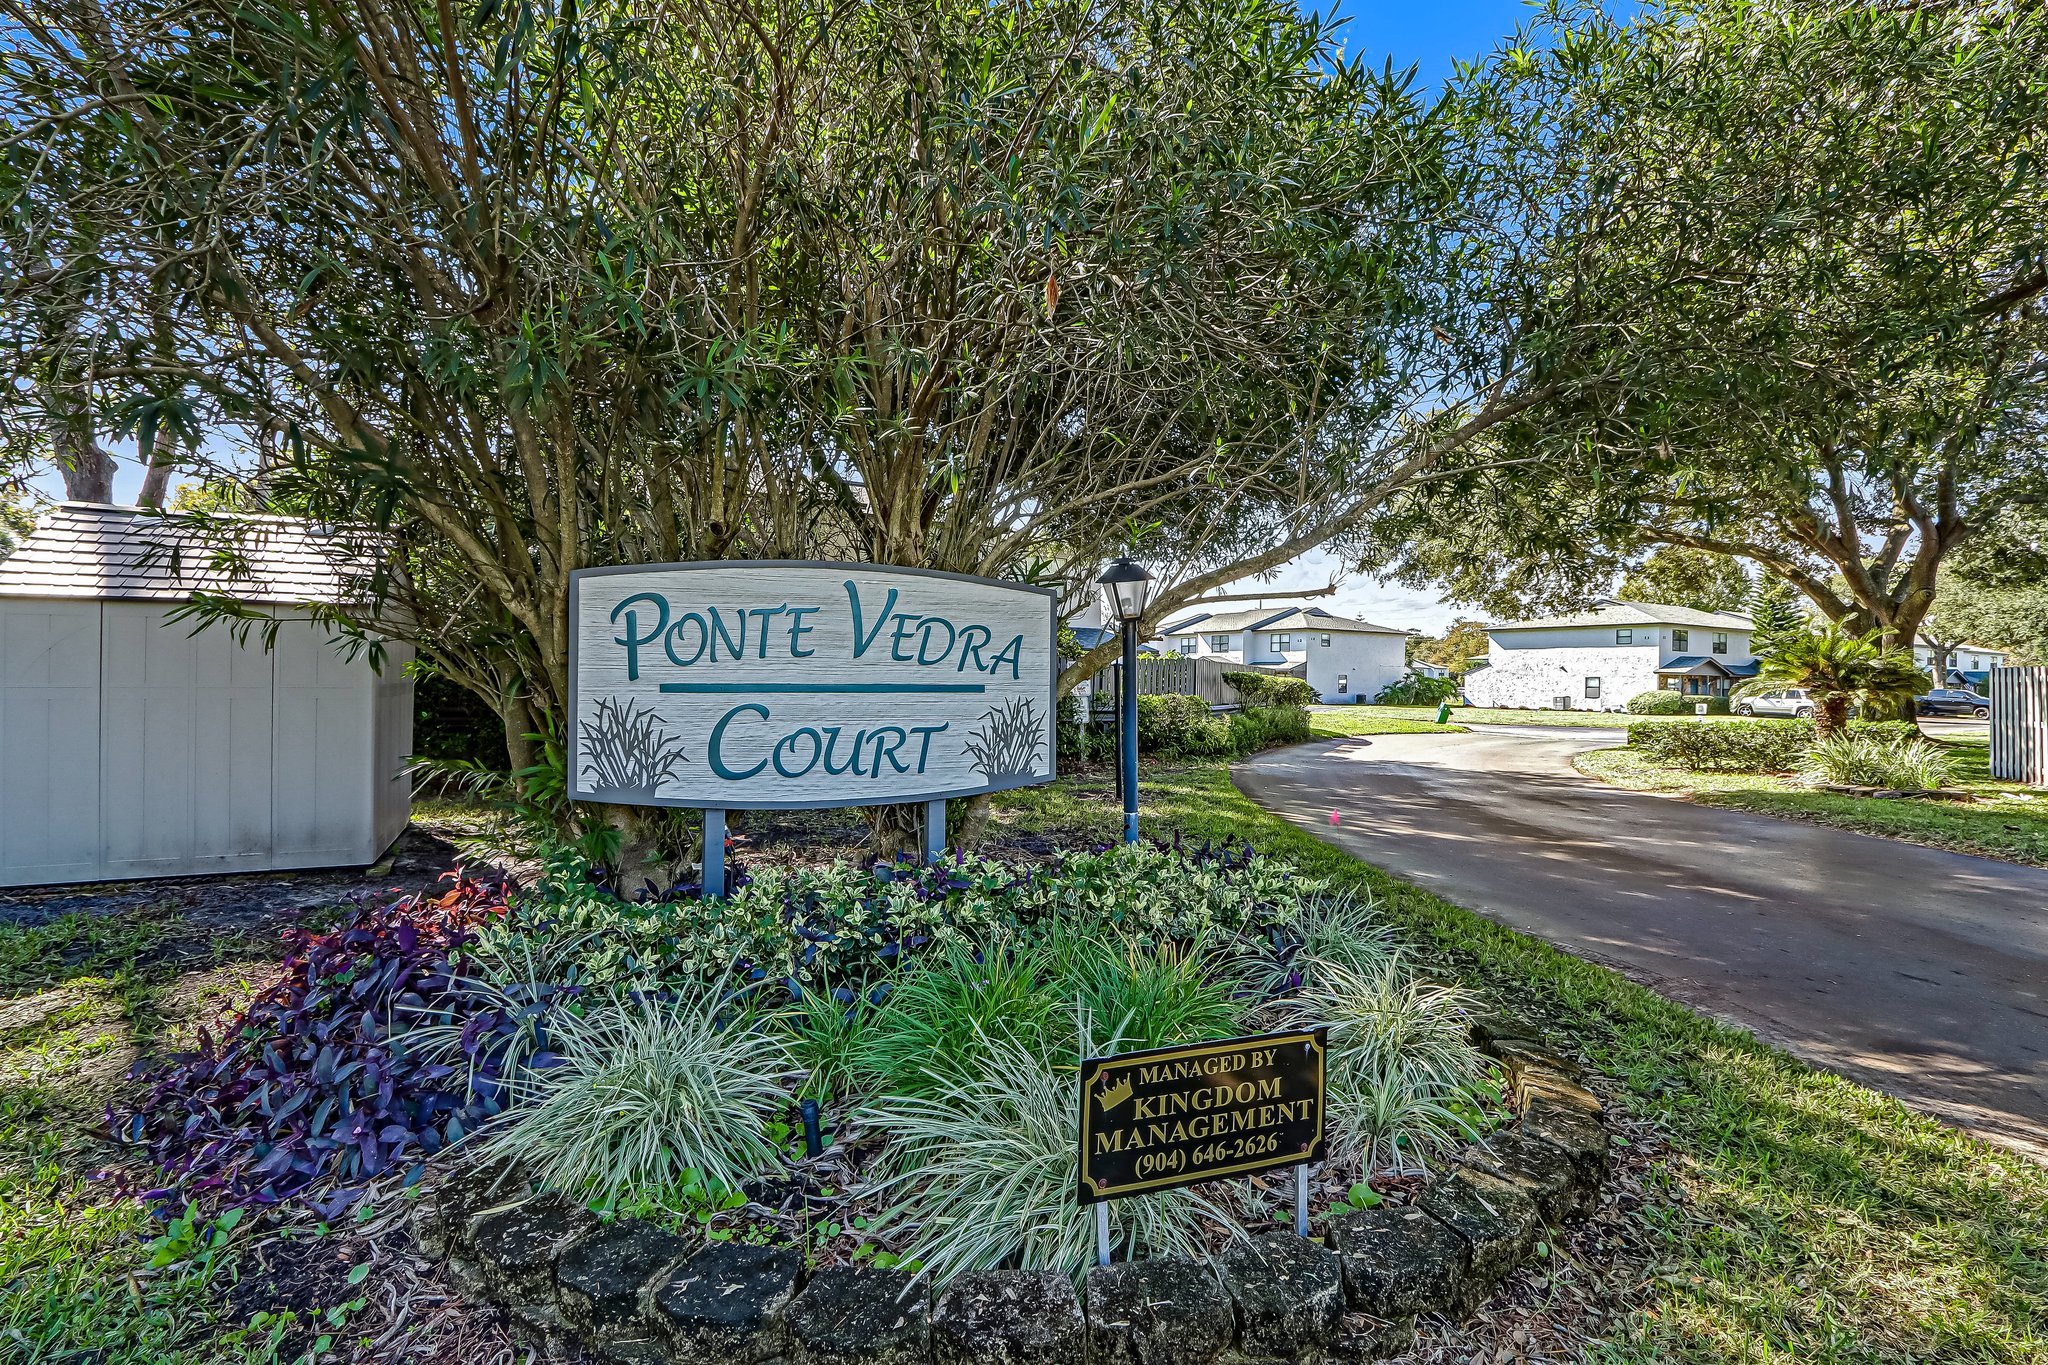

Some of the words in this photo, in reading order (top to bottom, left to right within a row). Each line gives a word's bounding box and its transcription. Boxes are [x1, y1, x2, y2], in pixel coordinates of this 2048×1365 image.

[610, 592, 821, 682] PONTE
[843, 580, 1024, 680] VEDRA
[707, 703, 950, 781] COURT
[1139, 1054, 1246, 1085] MANAGED
[1251, 1049, 1278, 1069] BY
[1133, 1076, 1282, 1120] KINGDOM
[1094, 1098, 1314, 1155] MANAGEMENT
[1134, 1149, 1187, 1179] (904)
[1192, 1132, 1278, 1166] 646-2626
